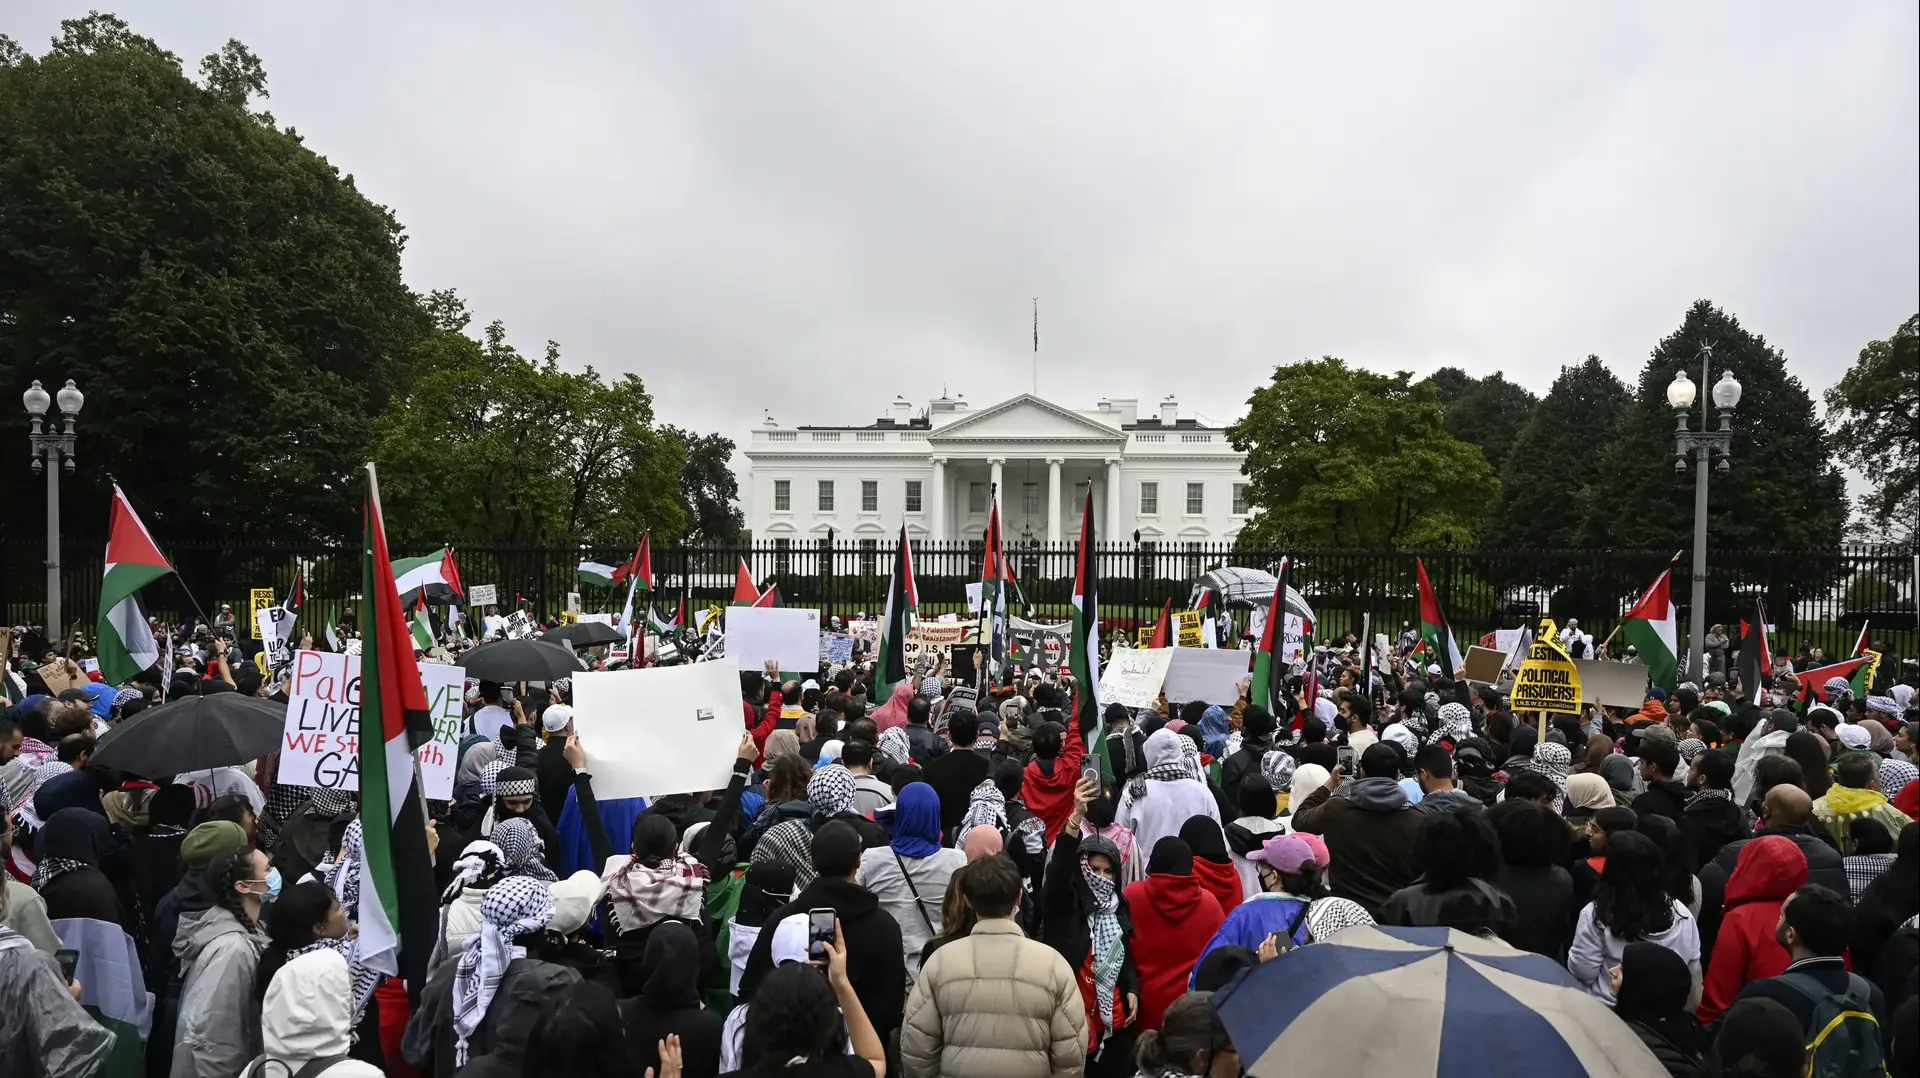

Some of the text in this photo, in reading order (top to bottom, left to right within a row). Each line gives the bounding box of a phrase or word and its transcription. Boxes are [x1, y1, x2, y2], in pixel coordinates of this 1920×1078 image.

[507, 613, 520, 624] NOT
[905, 643, 919, 652] OP
[905, 656, 935, 665] Isrli
[1521, 669, 1572, 685] POLITICAL
[1516, 684, 1576, 700] PRISONERS!
[1548, 701, 1575, 710] Coalition
[285, 731, 327, 754] WE
[313, 751, 360, 788] GA
